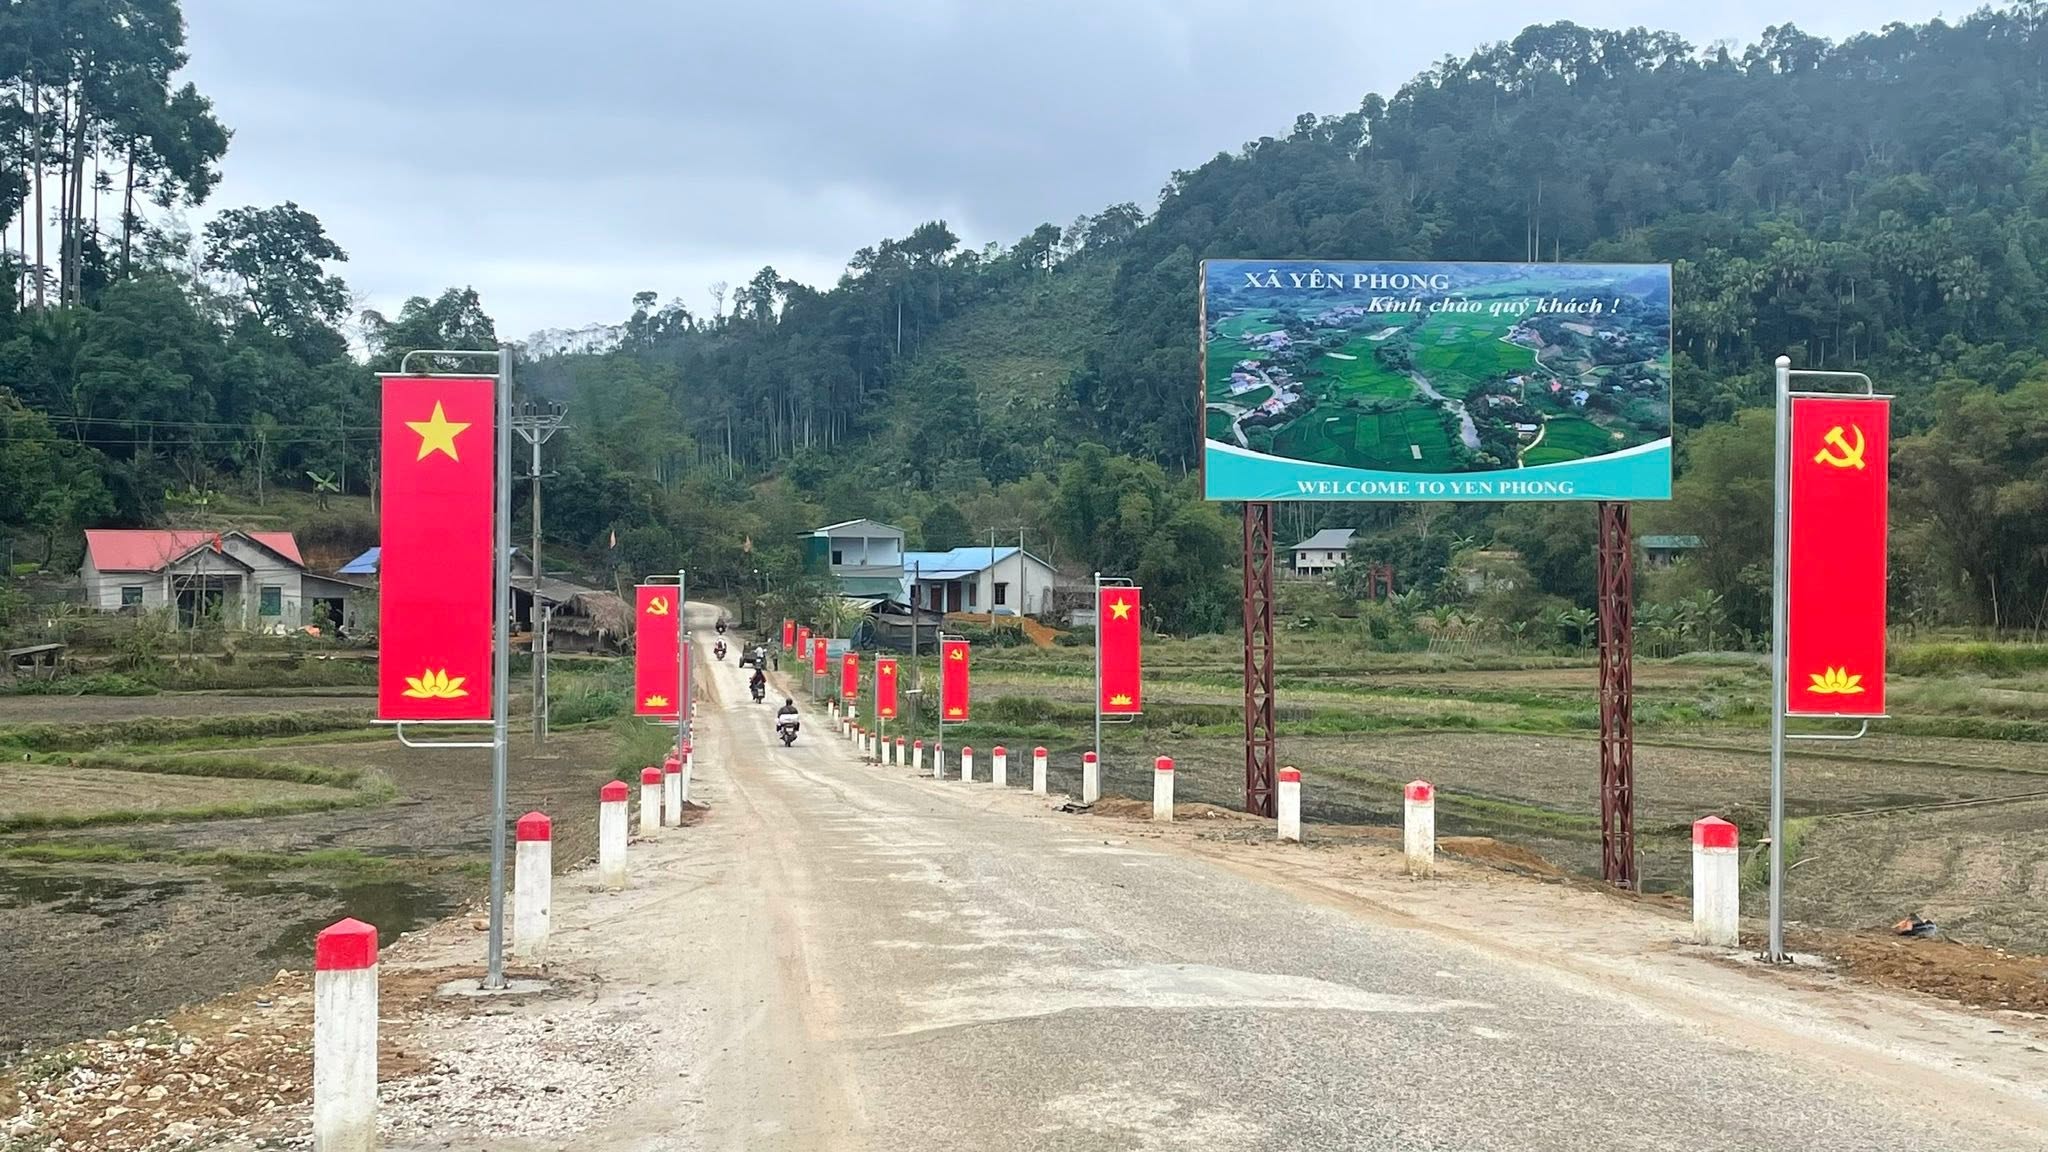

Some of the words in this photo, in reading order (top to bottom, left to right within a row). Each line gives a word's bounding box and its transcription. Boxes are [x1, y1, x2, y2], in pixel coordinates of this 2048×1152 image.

[1244, 268, 1283, 289] XÃ
[1288, 268, 1345, 290] YÊN
[1353, 273, 1449, 290] PHONG
[1429, 297, 1482, 313] chào
[1535, 297, 1603, 313] khách
[1610, 298, 1620, 314] !
[1297, 480, 1410, 495] WELCOME
[1415, 480, 1446, 495] TO
[1450, 480, 1493, 495] YEN
[1499, 480, 1574, 495] PHONG
